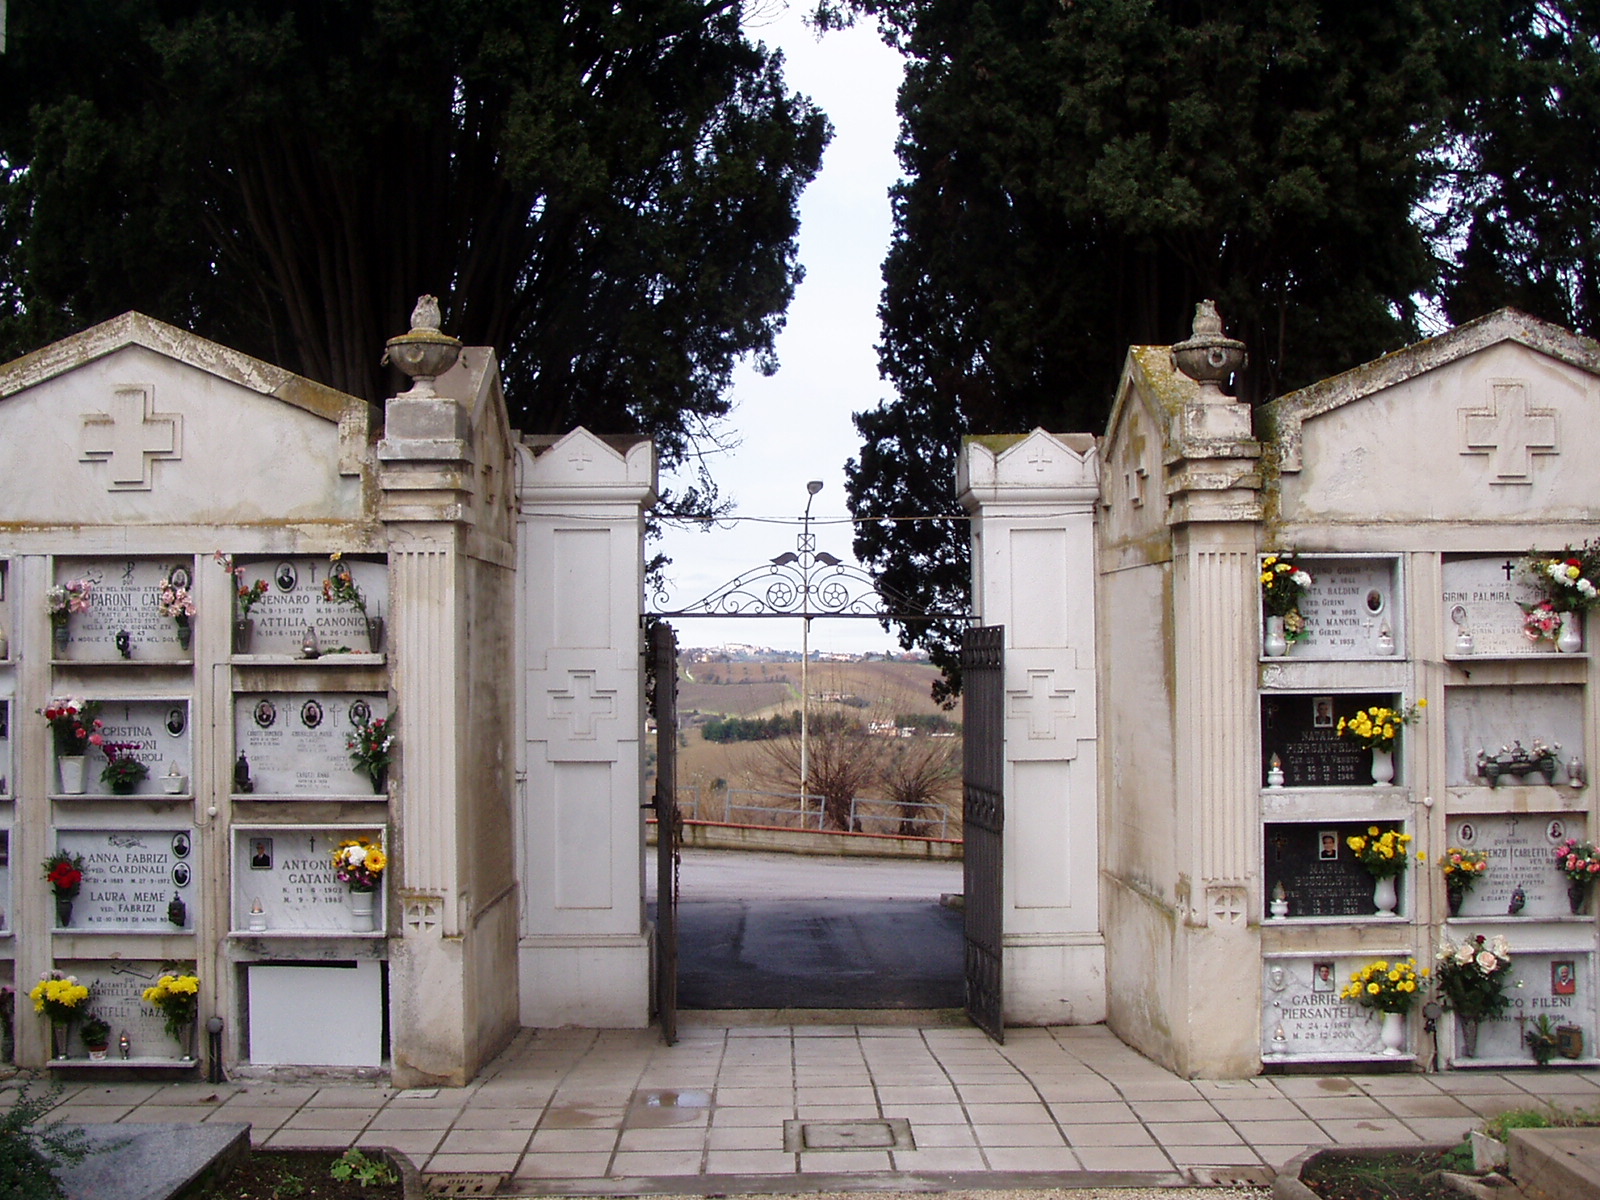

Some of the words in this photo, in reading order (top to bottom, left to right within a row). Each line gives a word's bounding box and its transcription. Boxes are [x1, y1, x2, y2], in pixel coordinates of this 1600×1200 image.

[260, 595, 310, 605] GENNARO
[1442, 592, 1469, 602] GIRINI
[1472, 592, 1511, 602] PALMIRA
[260, 617, 308, 627] ATTILIA
[316, 617, 366, 627] CANONIC
[1326, 618, 1360, 626] MANCINI
[1319, 628, 1341, 636] GIRINI
[102, 726, 152, 737] CRISTINA
[88, 853, 119, 863] ANNA
[126, 853, 168, 863] FABRIZI
[282, 859, 332, 870] ANTONI
[288, 873, 336, 884] CATANI
[90, 892, 126, 902] LAURA
[118, 904, 156, 912] FABRIZI
[1531, 997, 1572, 1008] FILENI
[1281, 1007, 1367, 1020] PIERSANTELLI
